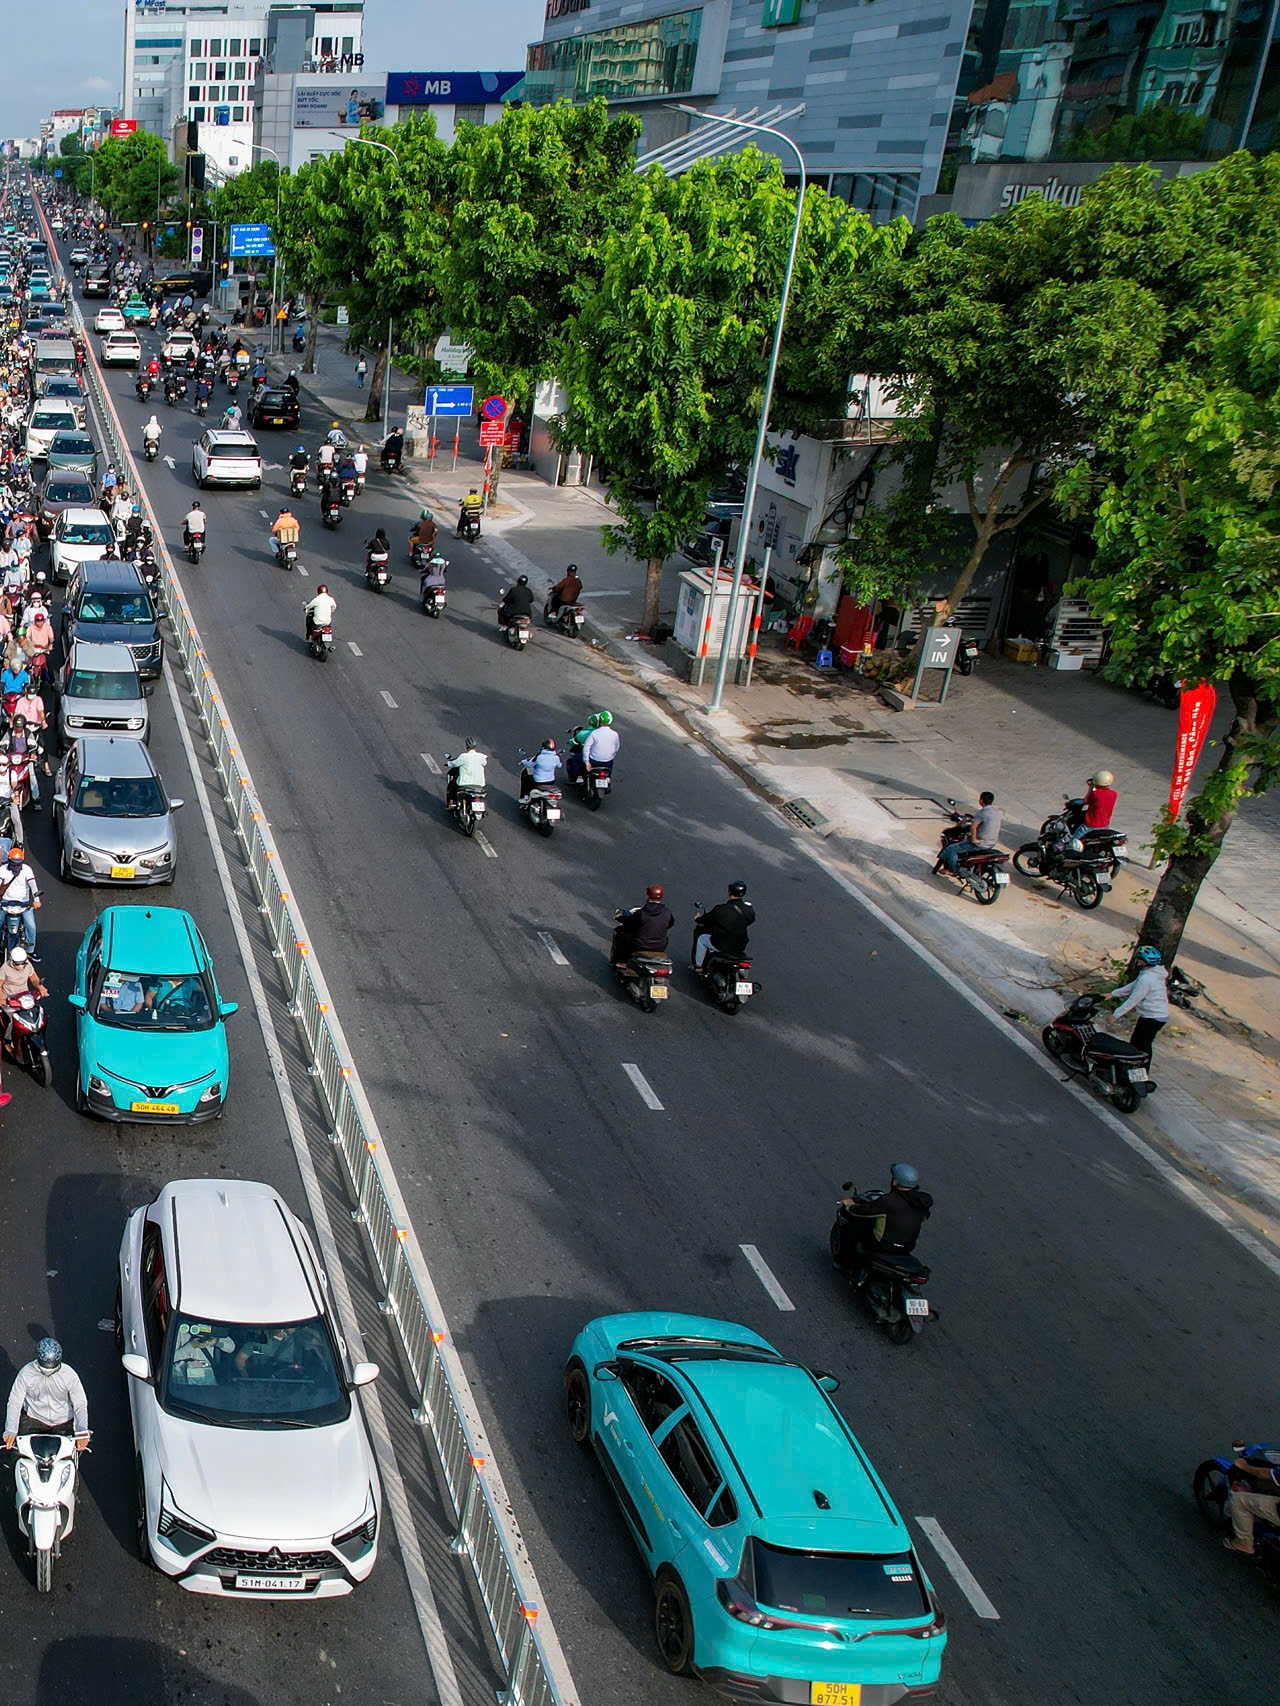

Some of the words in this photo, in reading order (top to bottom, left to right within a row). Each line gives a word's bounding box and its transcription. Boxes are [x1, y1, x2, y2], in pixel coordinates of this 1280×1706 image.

[340, 53, 365, 66] MB
[424, 80, 451, 95] MB
[931, 651, 948, 663] IN
[1177, 732, 1188, 773] PERFORMANCE
[825, 1683, 848, 1694] 50H
[816, 1693, 856, 1706] 877.51
